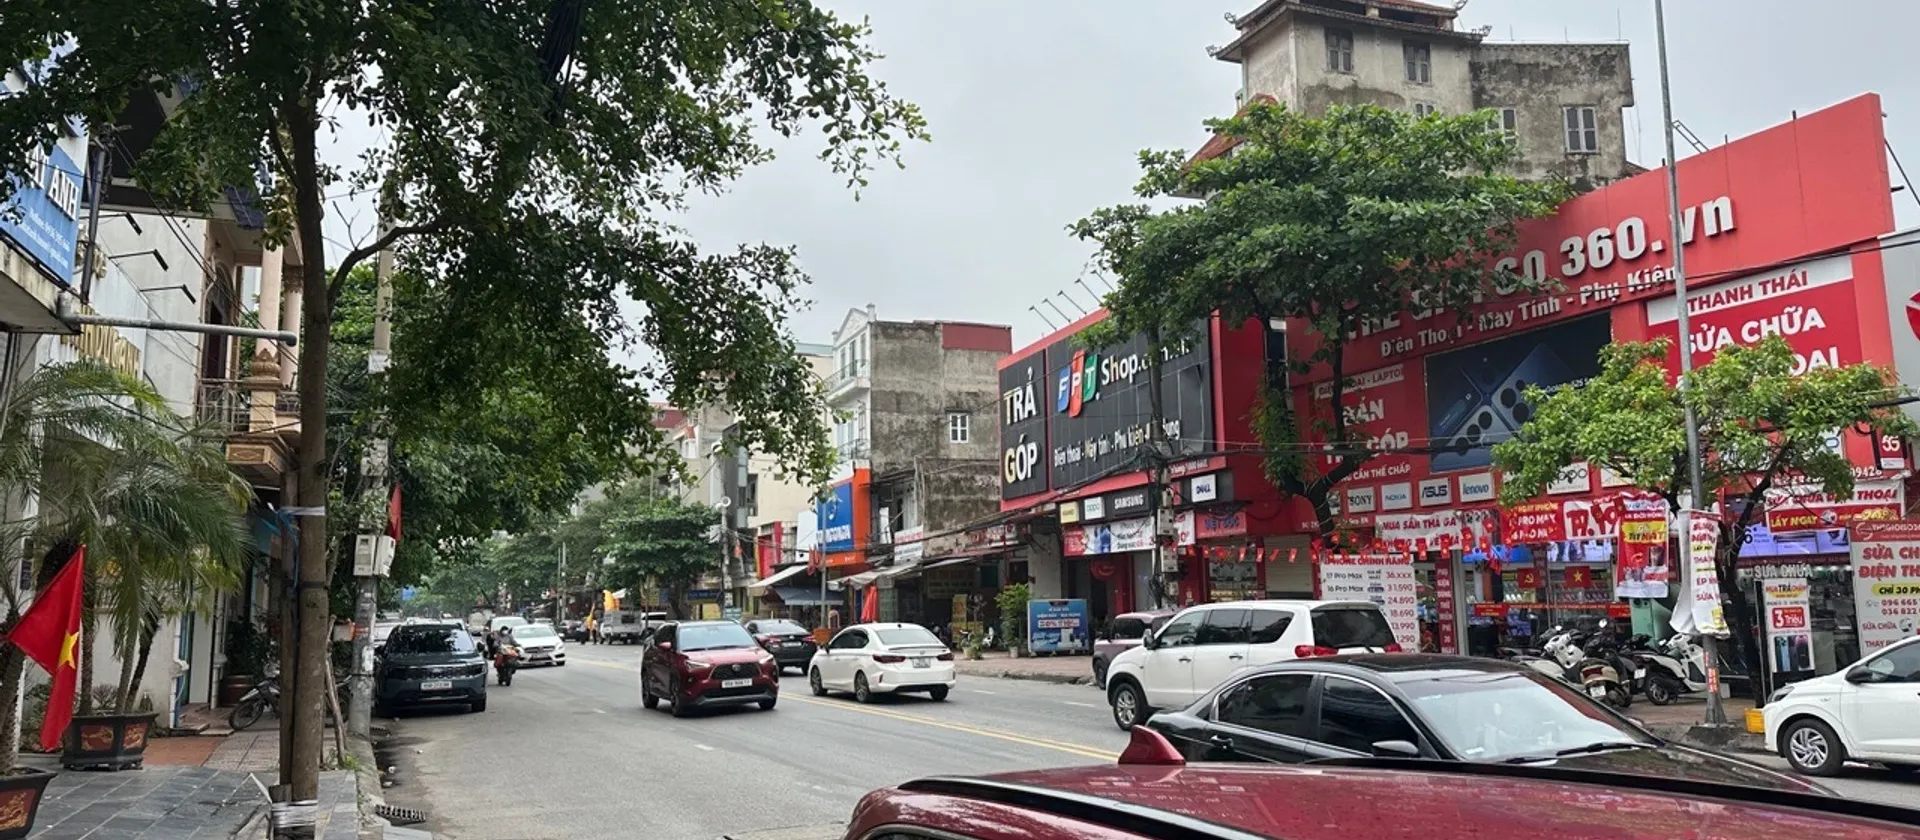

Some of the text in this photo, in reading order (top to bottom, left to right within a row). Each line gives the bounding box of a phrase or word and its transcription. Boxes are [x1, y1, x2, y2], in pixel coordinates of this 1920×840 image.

[47, 164, 79, 221] ANH
[1687, 268, 1808, 313] THANH THÁI
[1517, 296, 1561, 321] Tính
[1741, 305, 1826, 343] CHỮA
[1057, 358, 1098, 410] FPT
[1003, 366, 1037, 425] TRẢ
[1004, 433, 1038, 483] GÓP
[1349, 494, 1372, 506] SONY
[1421, 484, 1448, 499] ASUS
[1857, 489, 1898, 502] THOẠI
[1114, 494, 1144, 510] SAMSUNG
[1518, 515, 1535, 526] PRO
[1790, 515, 1818, 526] NGAY
[1862, 543, 1894, 560] SỬA
[1858, 562, 1897, 581] ĐIỆN
[1896, 586, 1908, 594] 30
[1774, 609, 1784, 627] 3
